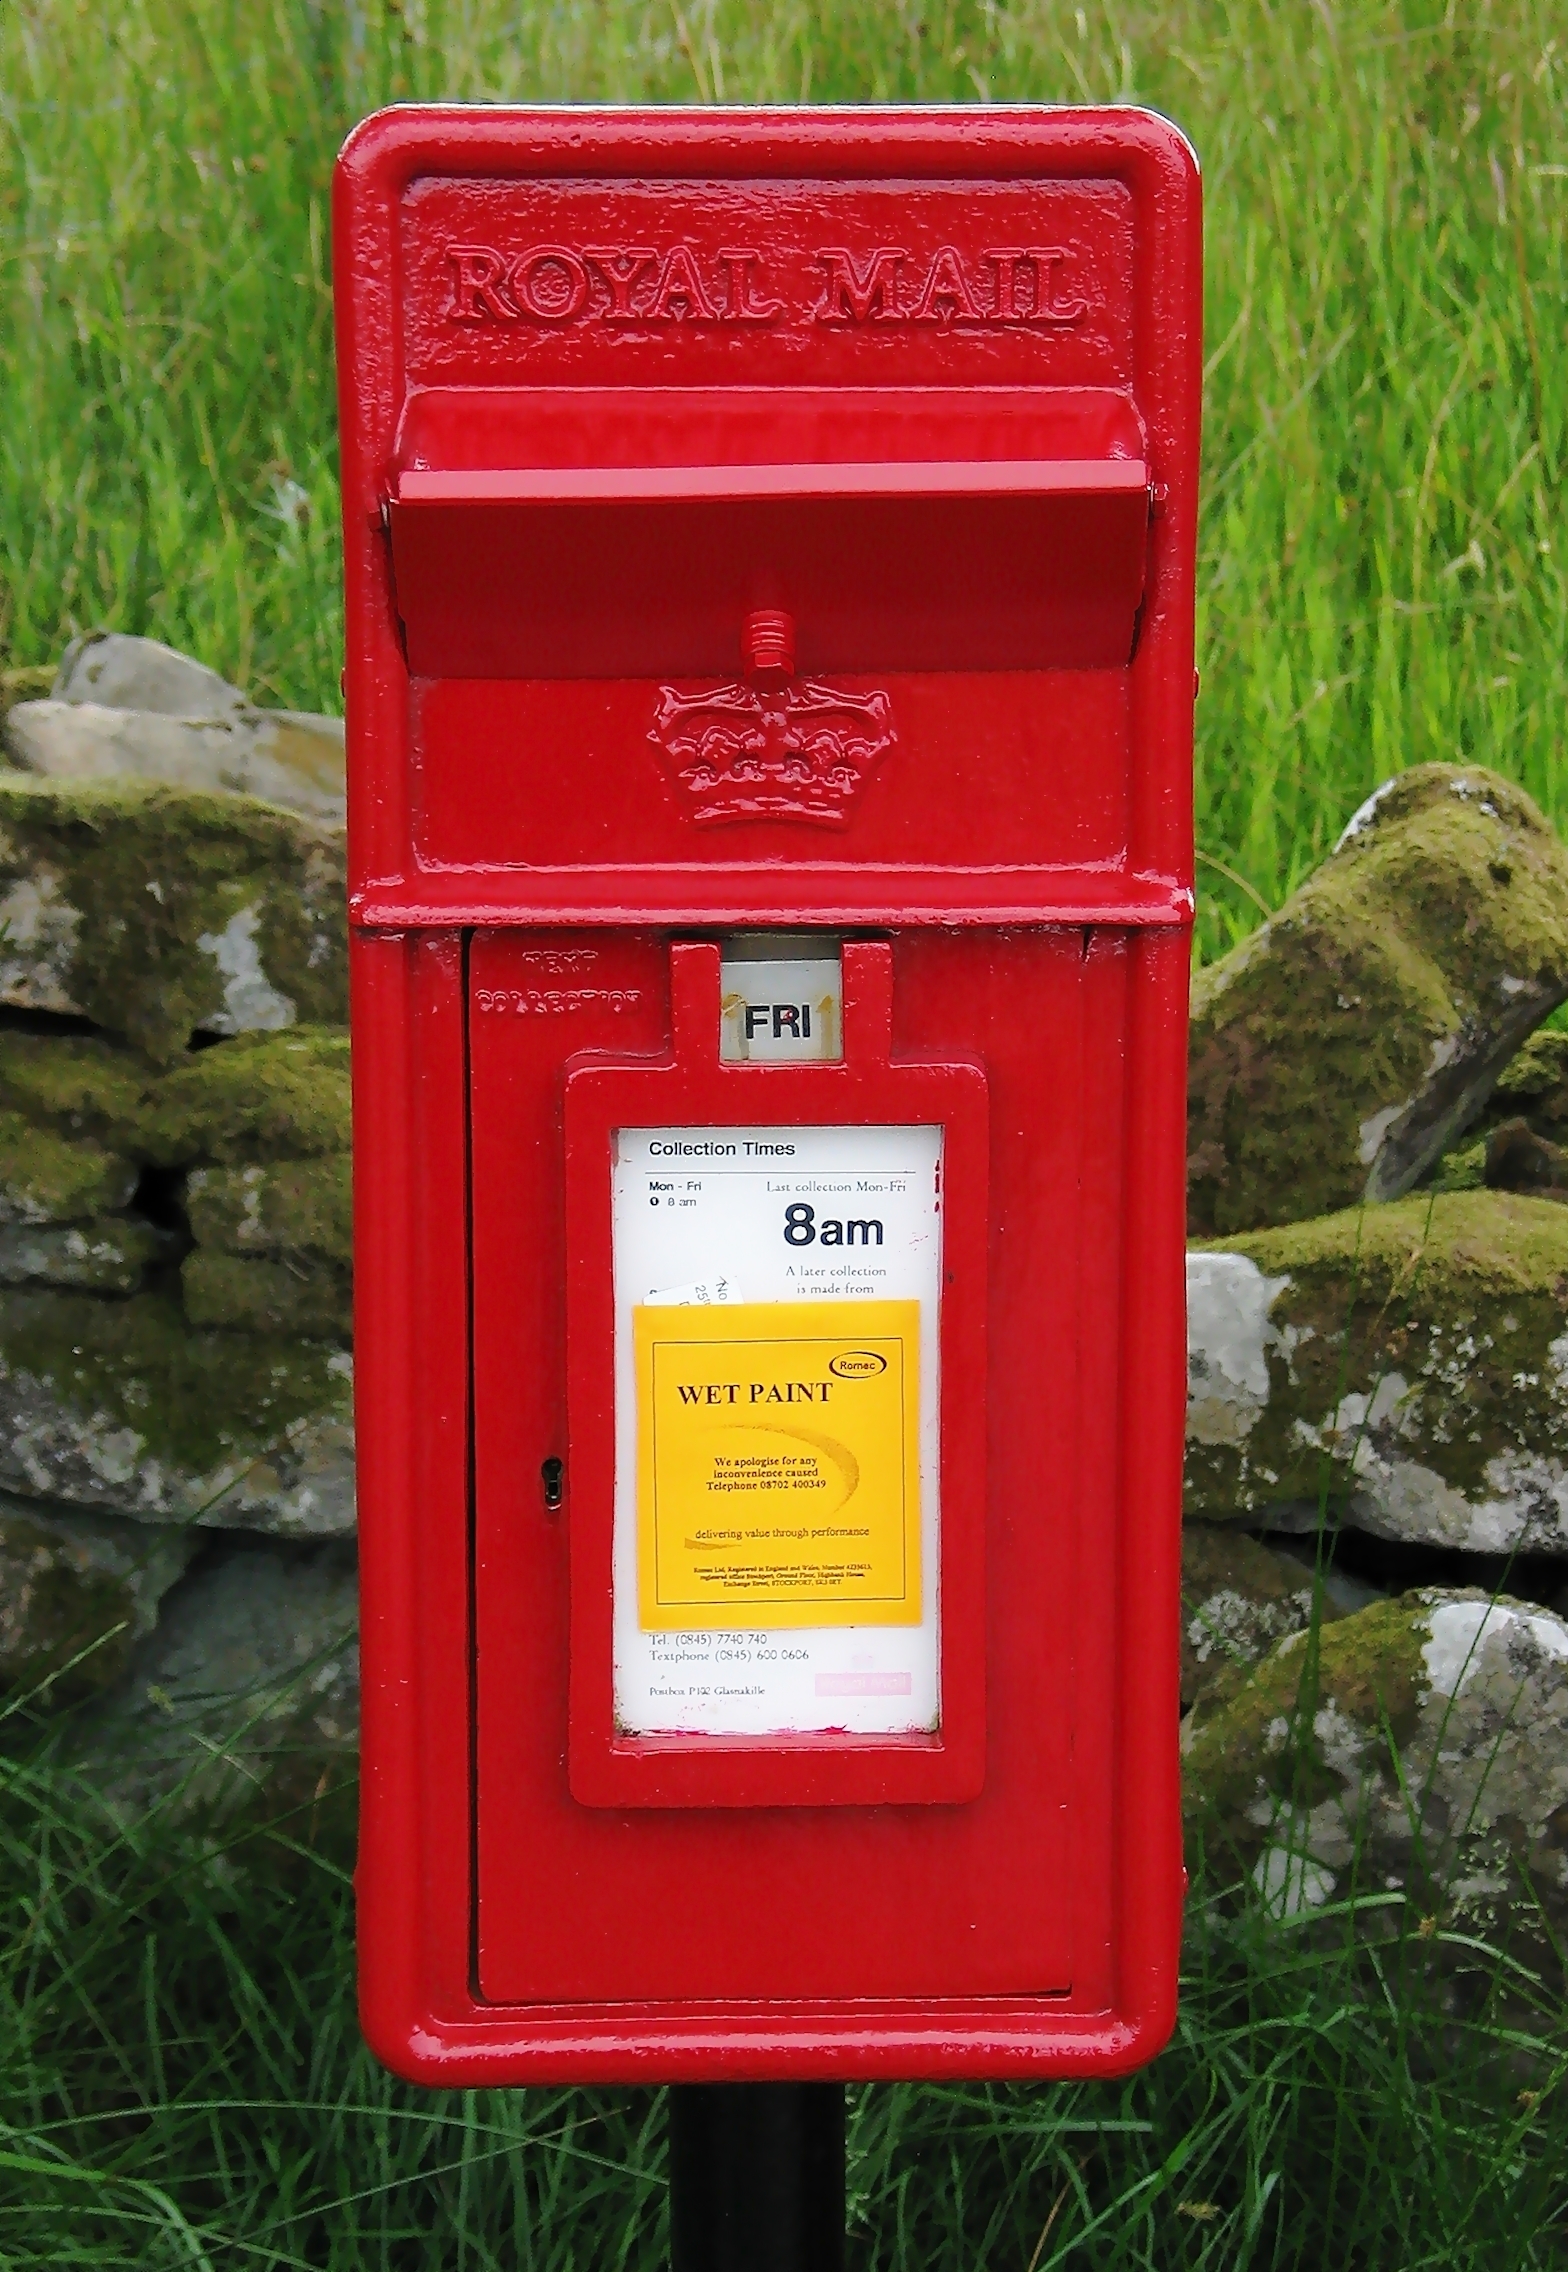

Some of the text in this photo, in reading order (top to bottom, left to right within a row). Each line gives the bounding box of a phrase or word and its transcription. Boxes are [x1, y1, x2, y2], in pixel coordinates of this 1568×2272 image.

[447, 243, 1090, 328] ROYAL MAIL
[745, 1004, 811, 1040] FRI
[648, 1141, 796, 1157] Collection Times
[649, 1181, 674, 1192] Mon
[686, 1181, 702, 1192] Fri
[766, 1181, 791, 1193] Last
[795, 1180, 852, 1193] collection
[783, 1202, 884, 1247] 8am
[786, 1264, 887, 1277] A later collection
[796, 1282, 875, 1296] is made from
[840, 1361, 876, 1371] Romec
[677, 1382, 834, 1405] WET PAINT
[714, 1456, 818, 1470] We apologise for any
[713, 1468, 818, 1479] inconvenience caused
[706, 1479, 827, 1492] Telephone 08702 400349
[695, 1527, 870, 1541] delivering value through performance
[649, 1634, 768, 1647] Tel. (0845) 7740 740
[649, 1649, 809, 1663] Textphone (0845) 600 0606
[649, 1687, 686, 1696] Postbox
